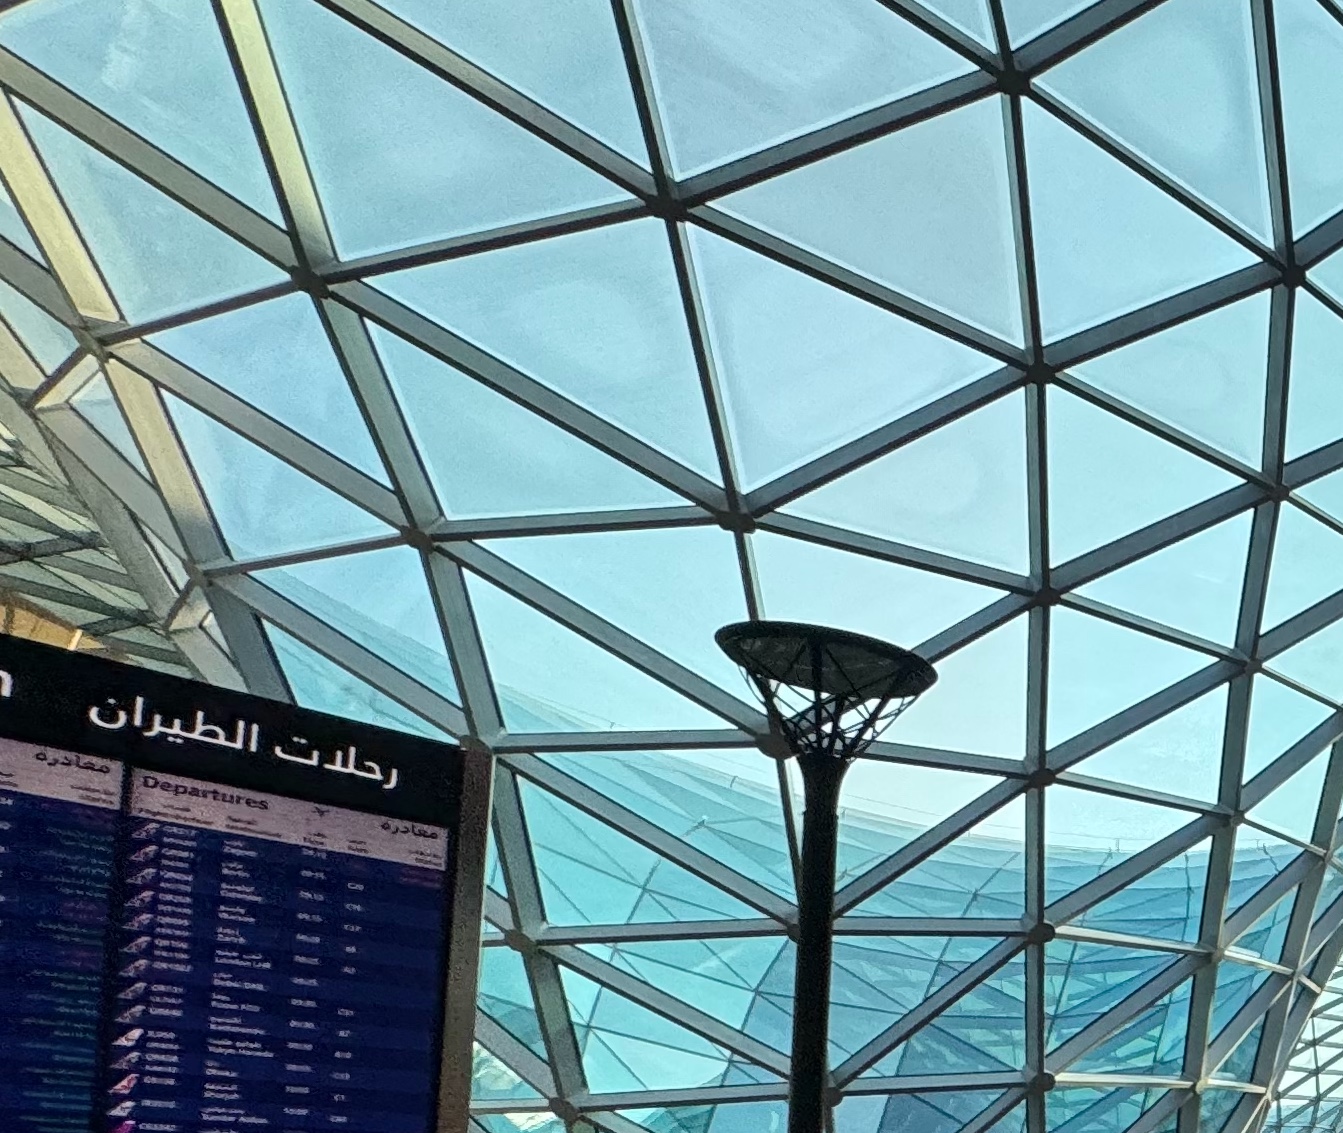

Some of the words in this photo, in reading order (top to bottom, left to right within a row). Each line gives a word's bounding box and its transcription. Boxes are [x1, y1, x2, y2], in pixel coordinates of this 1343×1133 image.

[88, 696, 259, 753] الطيران
[274, 737, 399, 790] رحلات
[142, 775, 269, 812] Departures
